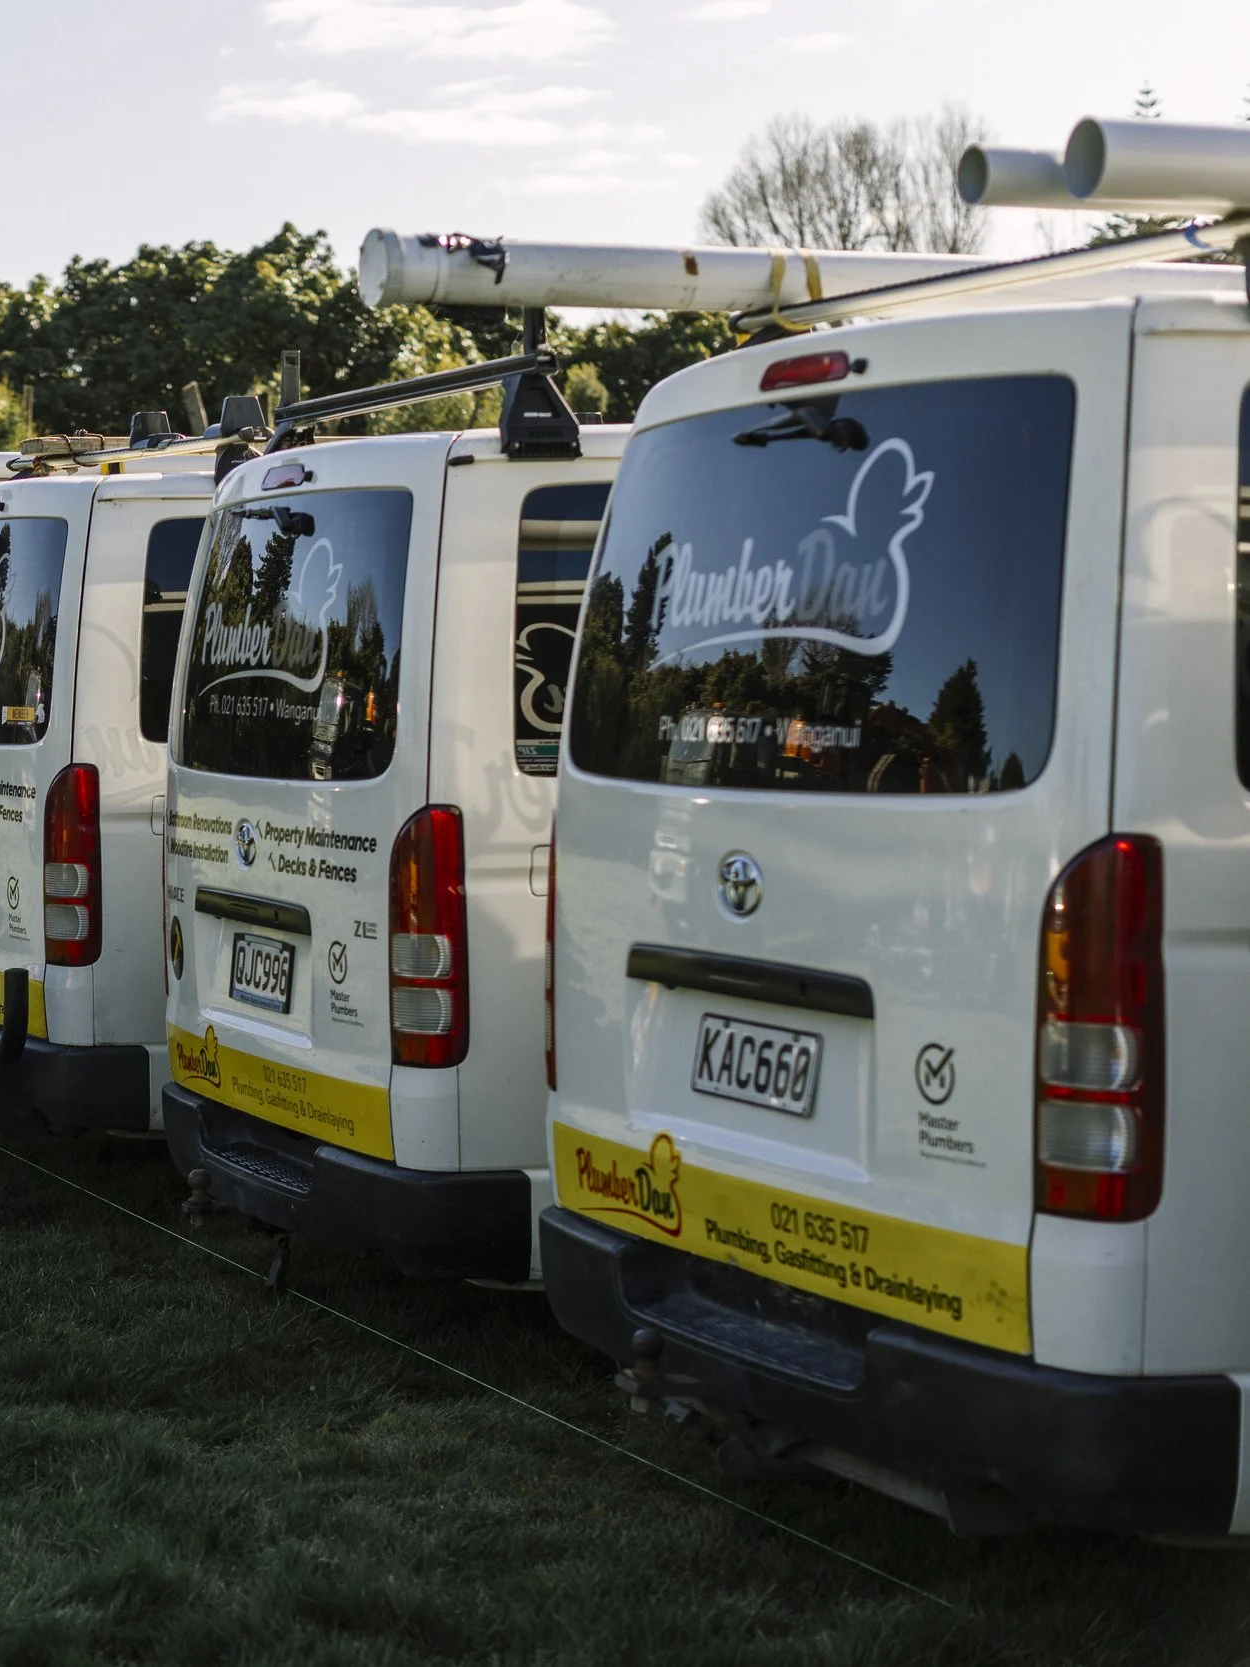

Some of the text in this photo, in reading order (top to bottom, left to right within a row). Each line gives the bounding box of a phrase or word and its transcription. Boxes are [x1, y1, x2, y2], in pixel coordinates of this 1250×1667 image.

[221, 695, 235, 716] 021
[236, 696, 251, 717] 635
[252, 696, 269, 717] 517
[275, 698, 321, 726] Wanganu
[680, 716, 704, 742] 021
[192, 813, 232, 835] Renovations
[264, 821, 378, 853] Property Maintenance
[192, 842, 229, 864] Installation
[277, 854, 357, 883] Decks & Fences
[235, 946, 288, 996] QJC996
[330, 989, 350, 1002] Master
[330, 1002, 358, 1018] Plumbers
[698, 1026, 812, 1102] KAC660
[262, 1065, 307, 1094] 021 635 517
[265, 1088, 300, 1119] Gasfitting
[300, 1102, 307, 1117] &
[307, 1102, 355, 1136] Drainlaying
[918, 1110, 960, 1131] Master
[918, 1129, 975, 1155] Plumbers
[770, 1202, 870, 1255] 021 635 517
[773, 1240, 848, 1288] Gasfitting
[849, 1261, 863, 1287] &
[863, 1265, 963, 1321] Drainlaying
